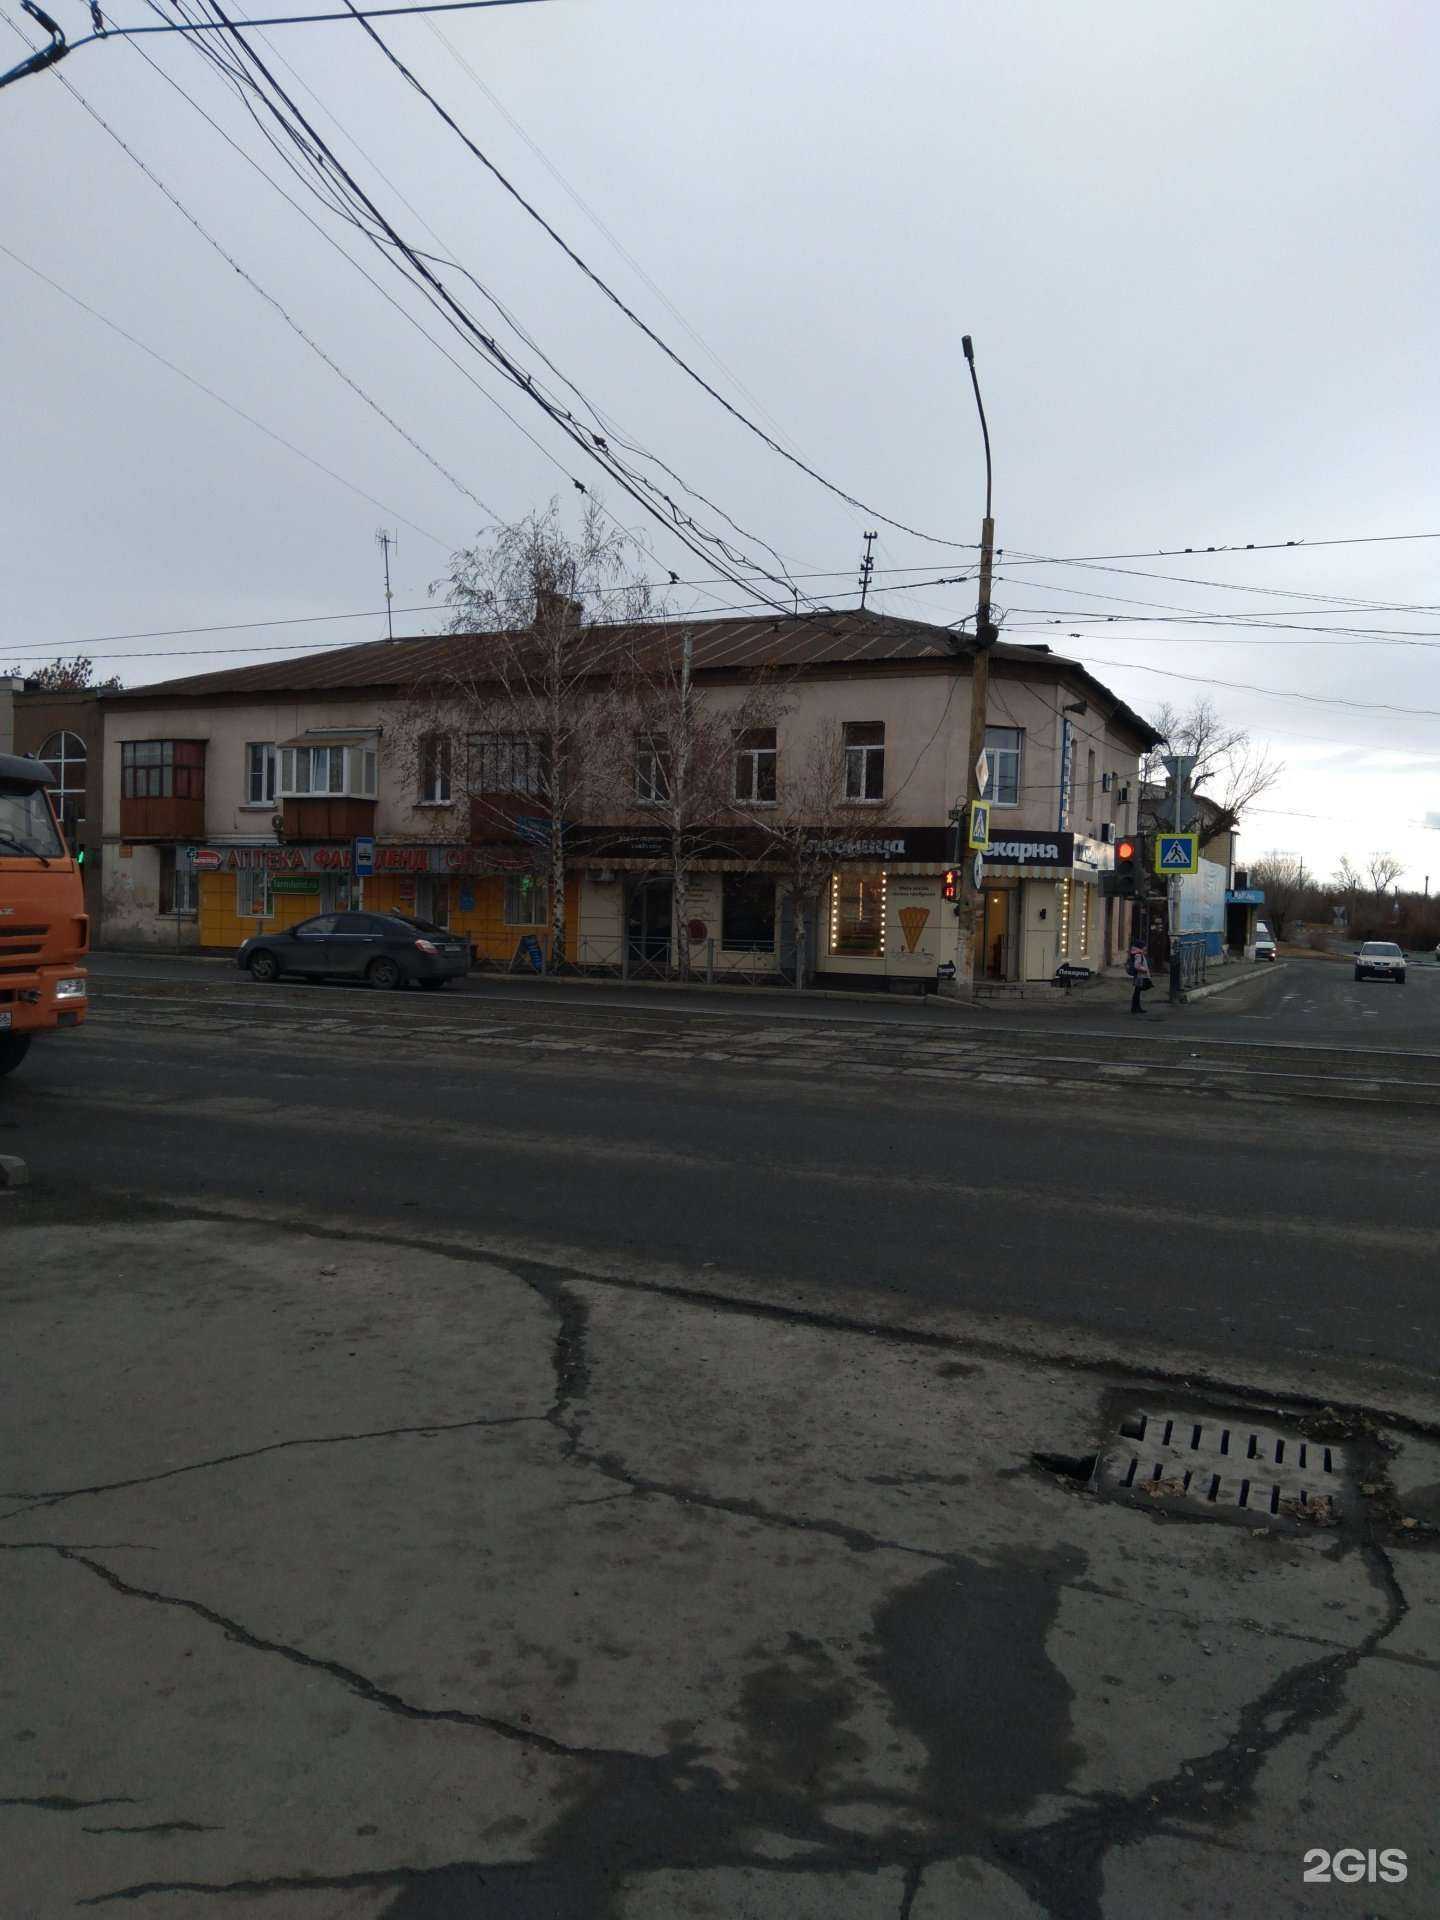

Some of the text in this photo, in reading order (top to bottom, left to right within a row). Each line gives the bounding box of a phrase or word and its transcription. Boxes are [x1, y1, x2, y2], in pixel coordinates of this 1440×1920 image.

[227, 848, 305, 868] АПТЕКА
[314, 847, 430, 871] ФАРЛЕНД
[982, 841, 1059, 863] екарня
